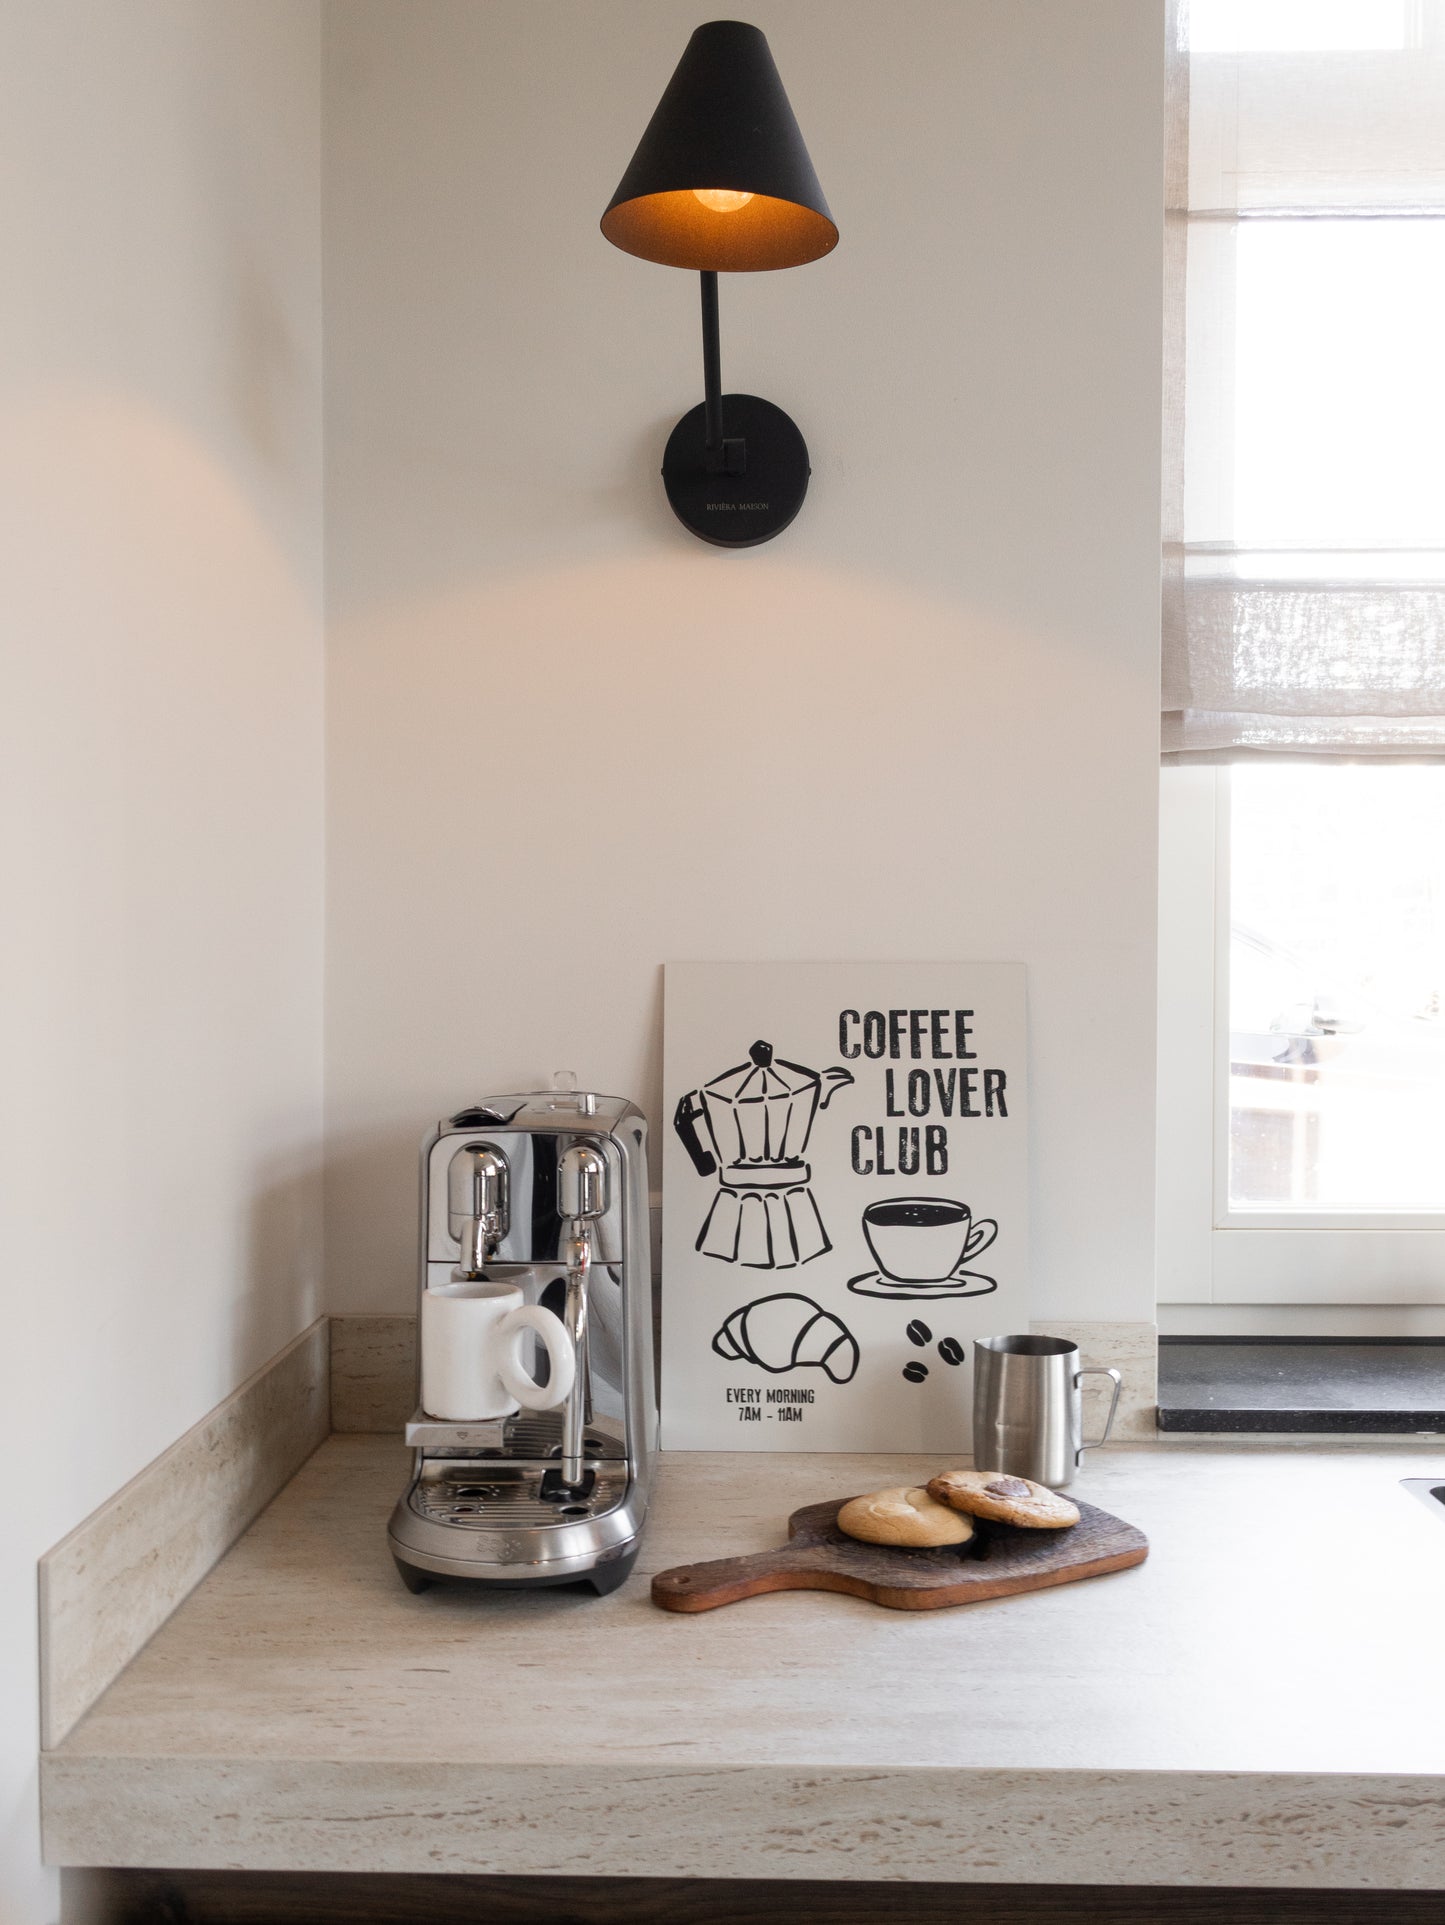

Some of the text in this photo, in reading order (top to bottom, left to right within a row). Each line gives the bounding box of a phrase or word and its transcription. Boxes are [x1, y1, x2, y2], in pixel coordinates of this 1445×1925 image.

[739, 502, 769, 511] MAISON
[839, 1009, 977, 1059] COFFEE
[885, 1067, 1008, 1117] LOVER
[851, 1124, 948, 1175] CLUB
[726, 1388, 815, 1404] EVERY MORNING
[738, 1406, 761, 1421] 7AM
[777, 1406, 803, 1422] 11AM
